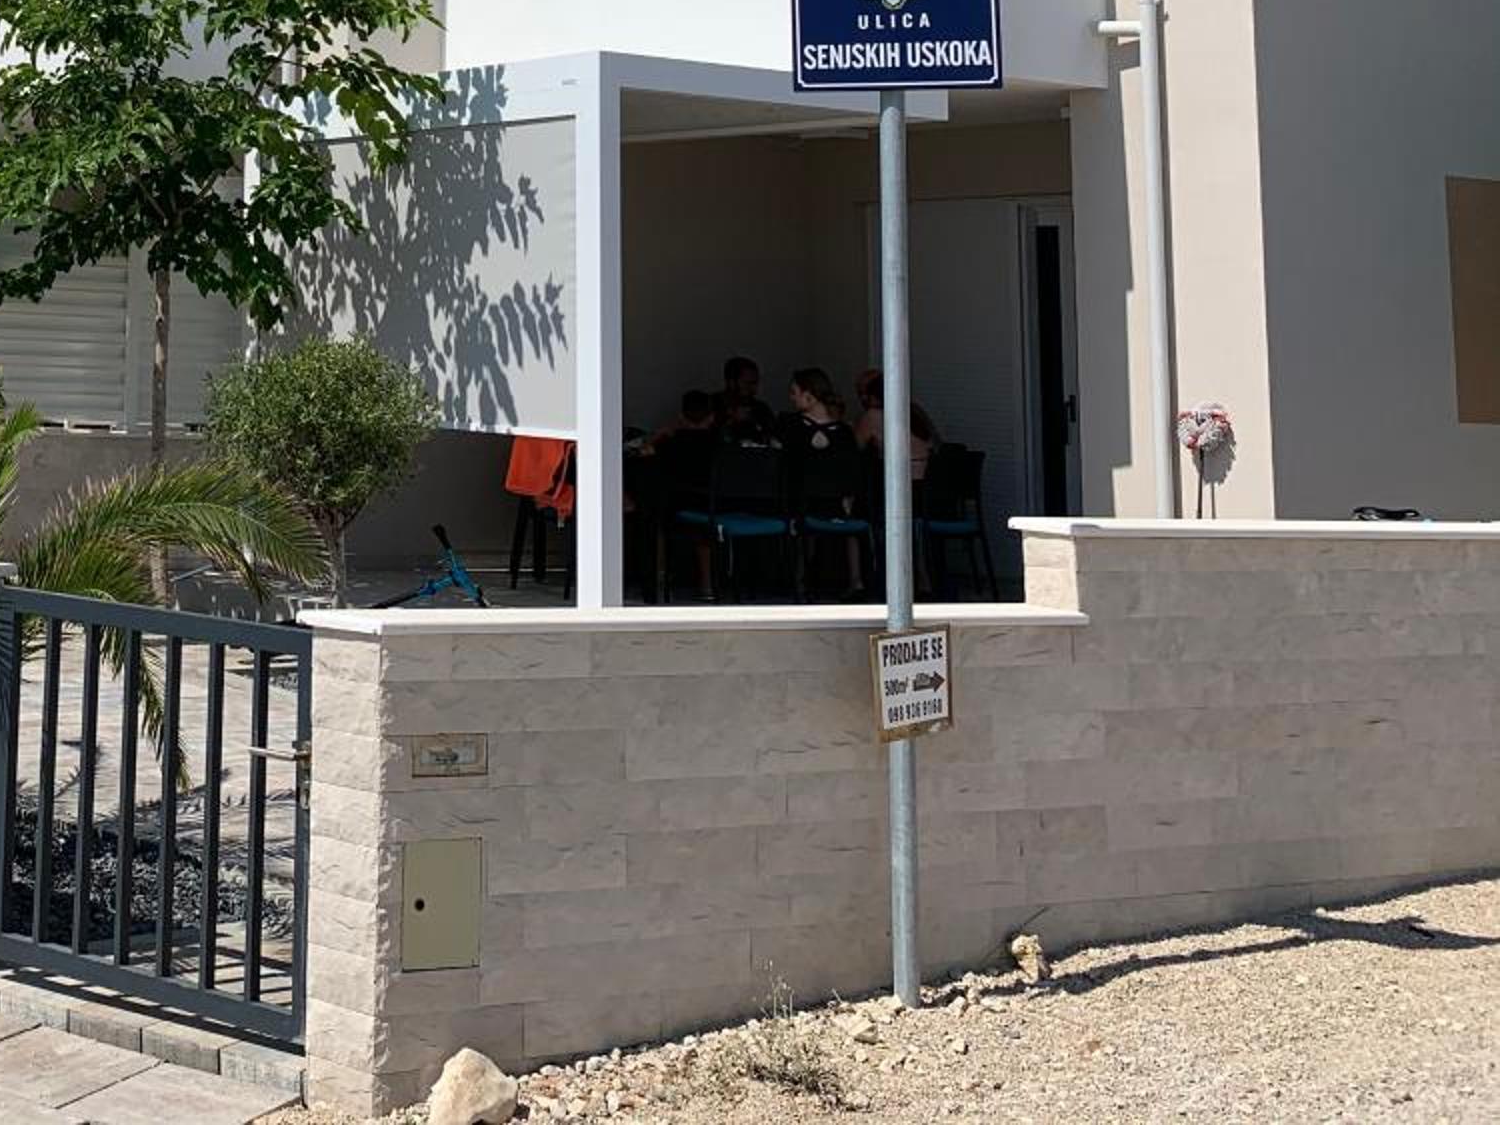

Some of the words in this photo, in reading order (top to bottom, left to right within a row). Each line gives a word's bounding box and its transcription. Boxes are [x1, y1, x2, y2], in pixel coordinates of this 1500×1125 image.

[857, 13, 931, 30] ULICA
[803, 42, 900, 70] SENJSKIH
[906, 40, 993, 68] USKOKA
[882, 639, 929, 667] PRODAJE
[931, 637, 942, 660] SE
